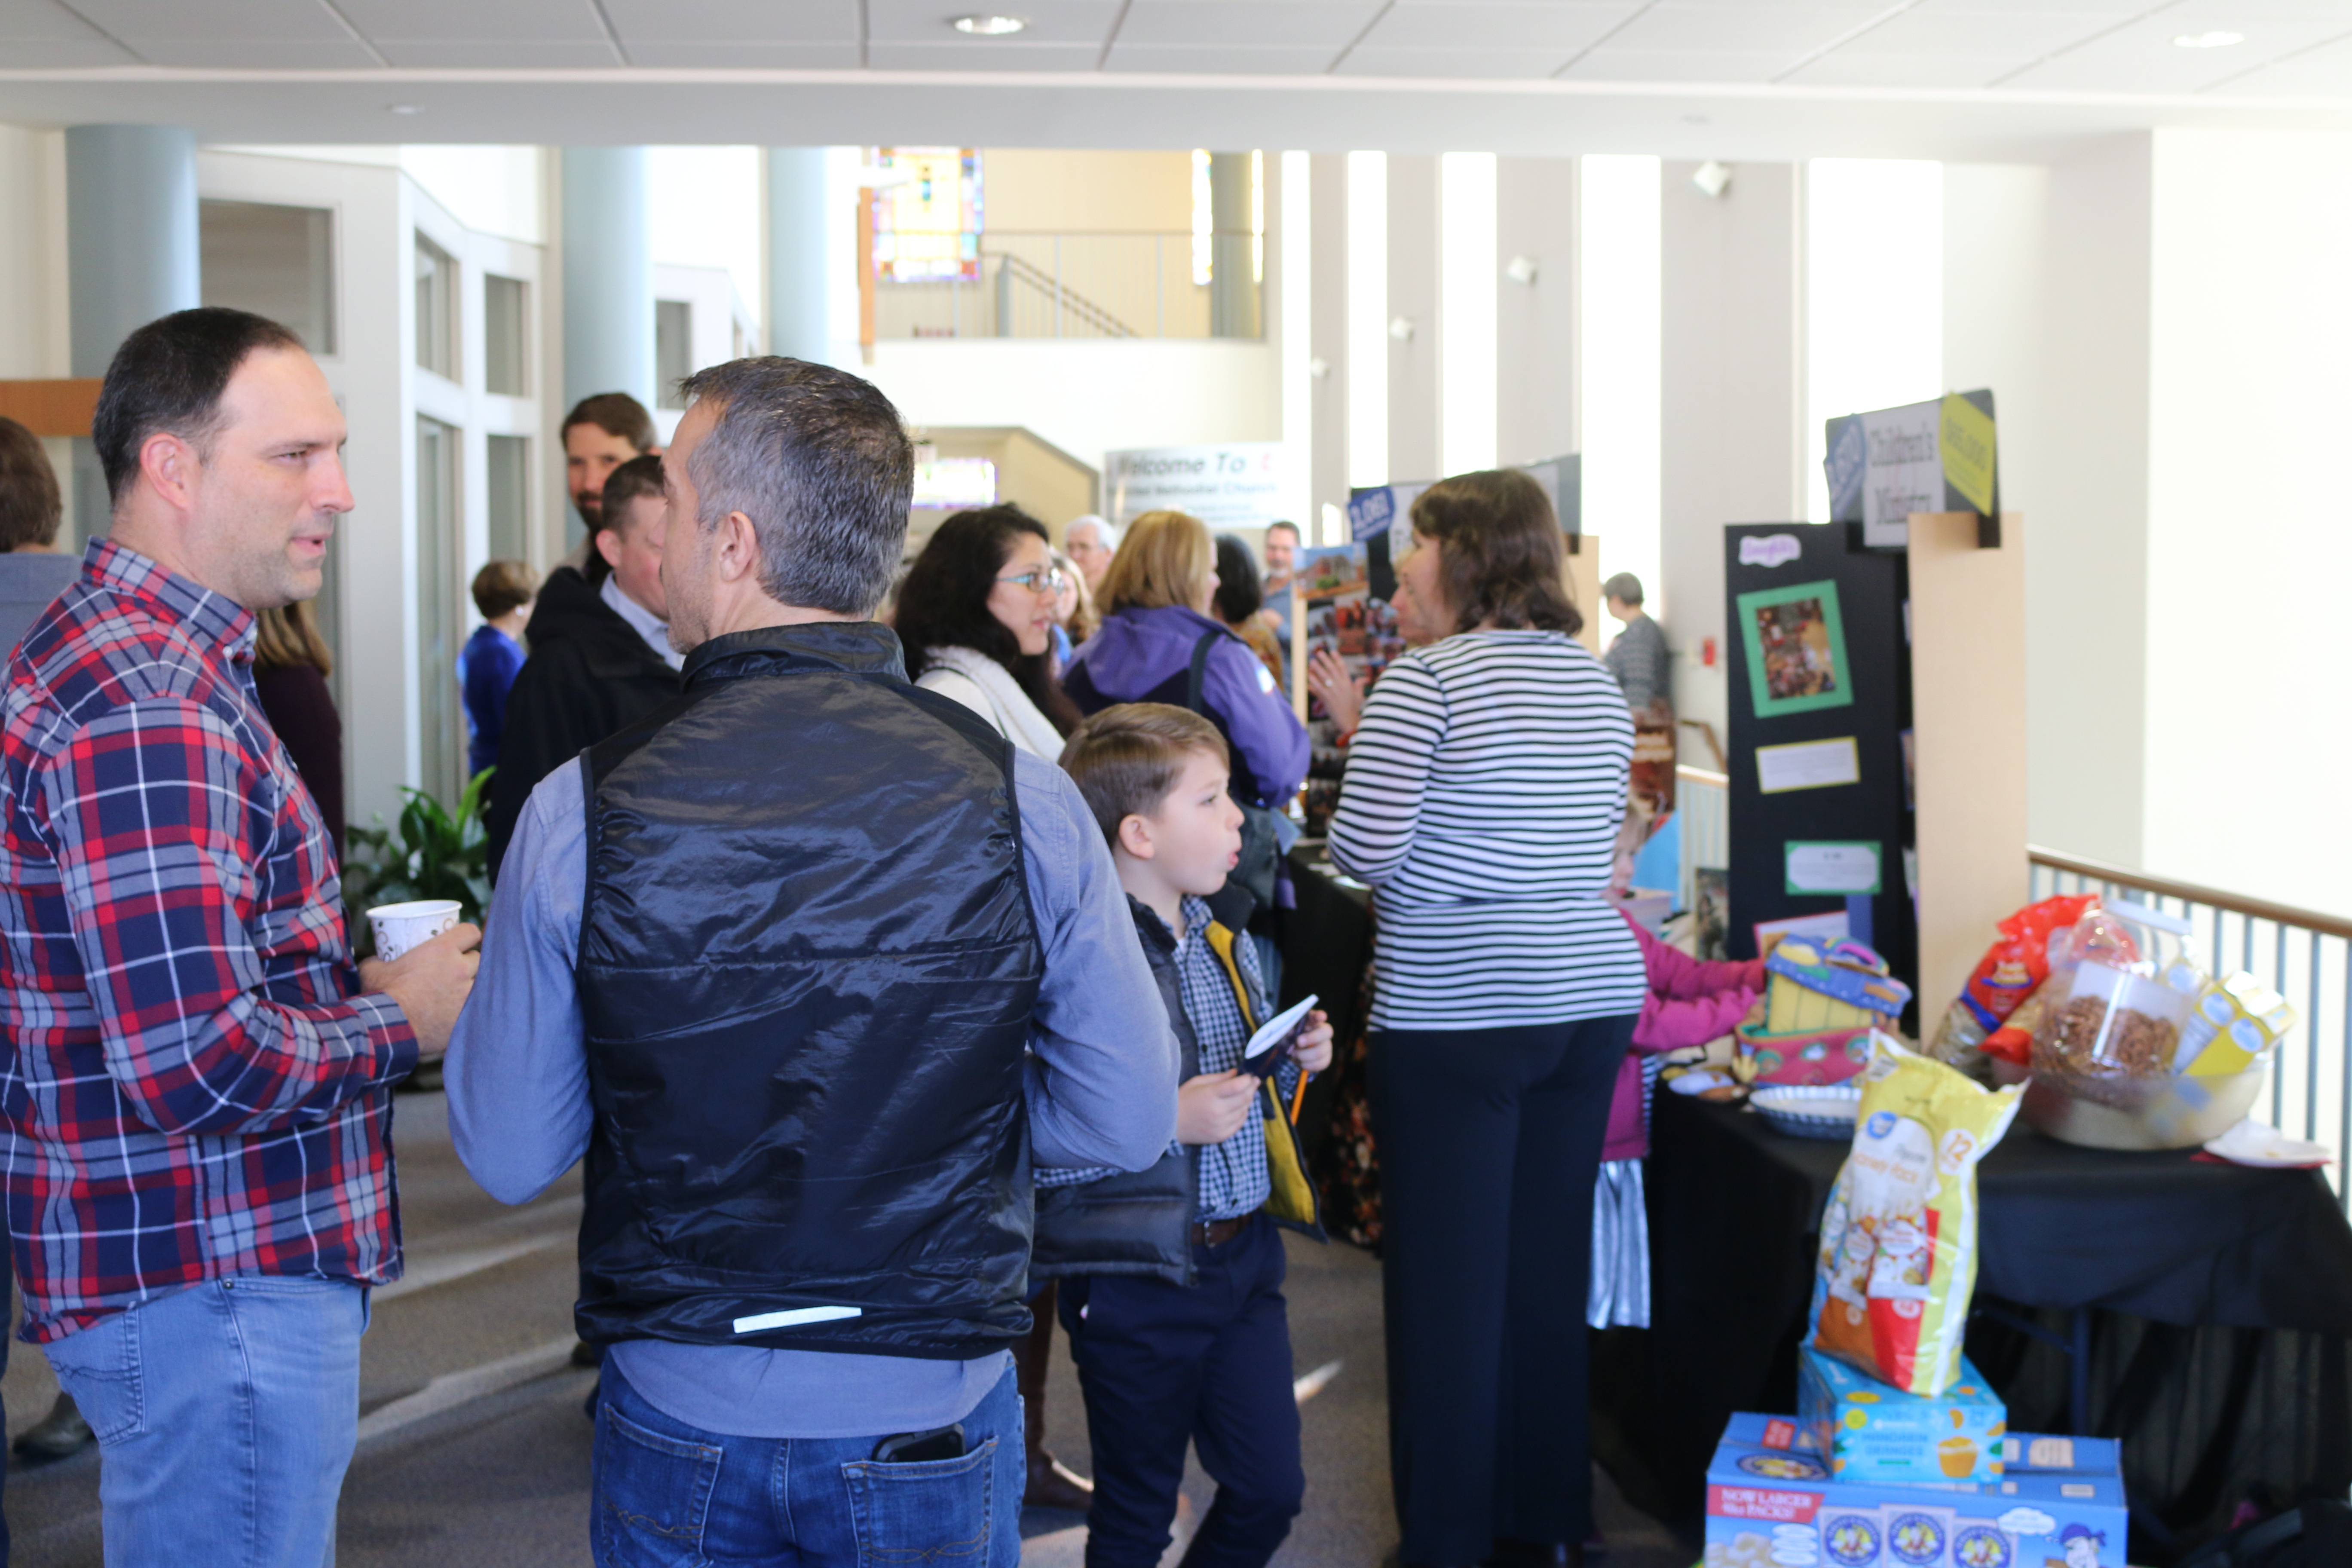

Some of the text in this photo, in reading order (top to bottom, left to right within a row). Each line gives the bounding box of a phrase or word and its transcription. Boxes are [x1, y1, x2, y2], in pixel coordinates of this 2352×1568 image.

[1216, 452, 1246, 473] To
[1947, 1133, 1972, 1161] 12
[1722, 1488, 1756, 1503] NOW
